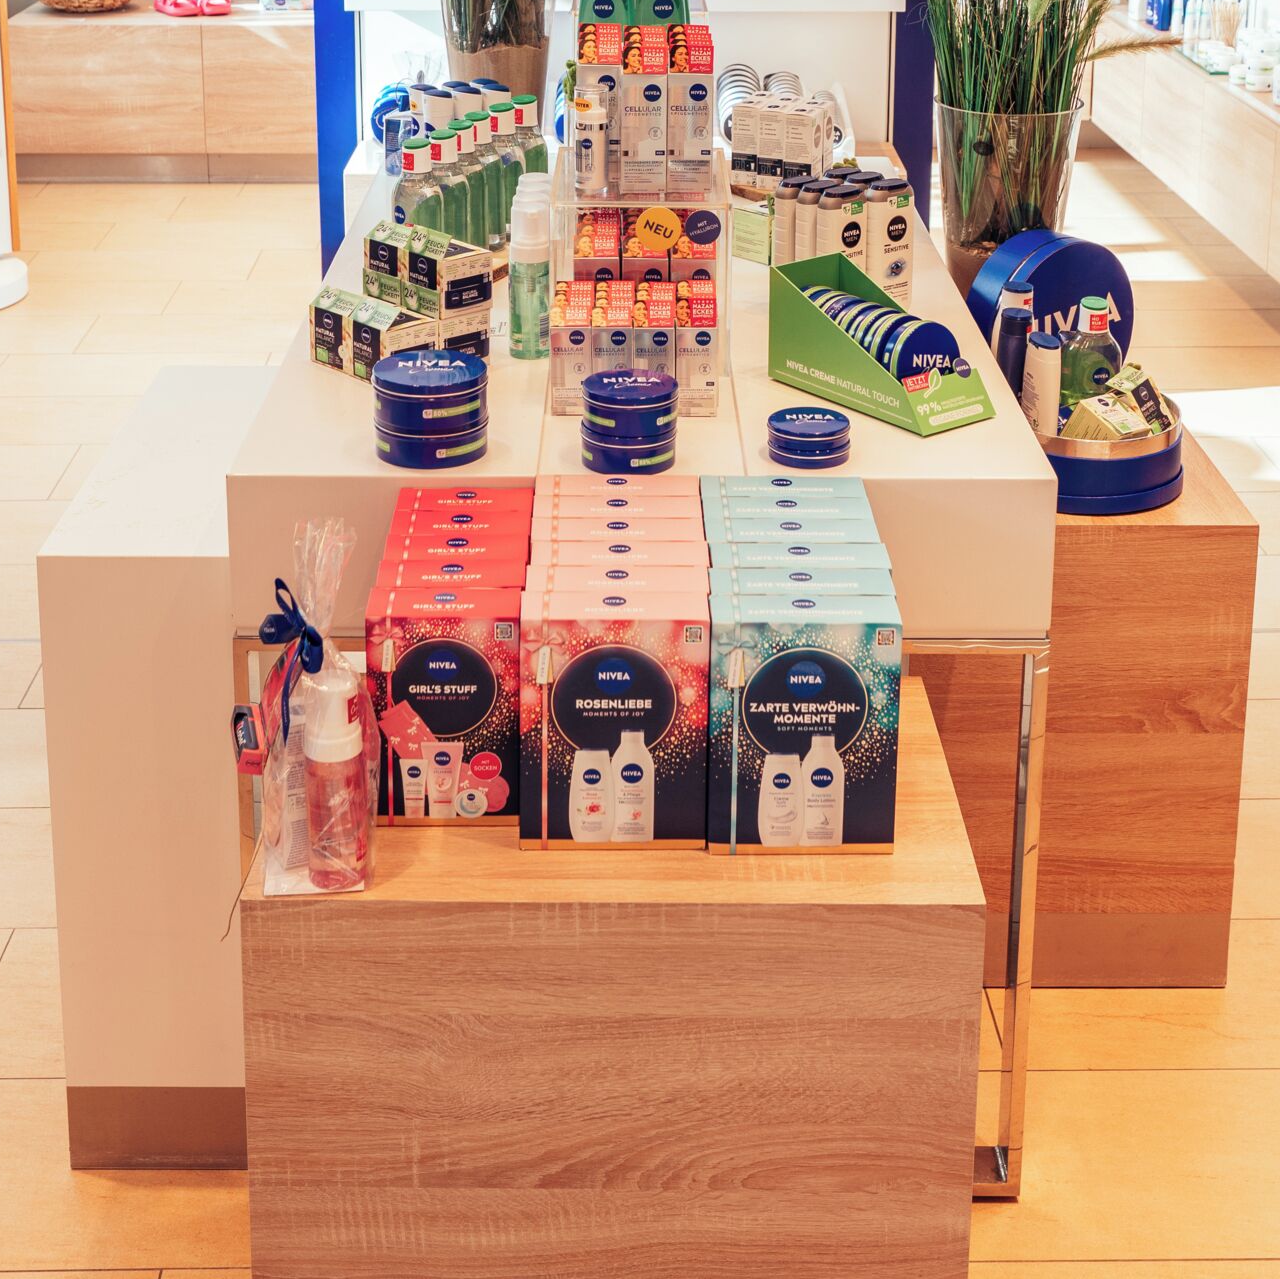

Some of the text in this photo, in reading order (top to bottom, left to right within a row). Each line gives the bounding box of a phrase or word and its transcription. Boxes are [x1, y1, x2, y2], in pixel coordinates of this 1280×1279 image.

[643, 219, 674, 239] NEU
[889, 223, 906, 232] NIVEA
[891, 228, 904, 236] MEN
[843, 229, 860, 238] NIVEA
[845, 234, 858, 243] MEN
[883, 244, 909, 254] SENSITIVE
[370, 260, 391, 270] NATURAL
[409, 273, 429, 283] NATURAL
[315, 327, 336, 338] NATURAL
[397, 359, 467, 368] NIVEA
[912, 354, 951, 369] NIVEA
[956, 364, 970, 372] NIVEA
[603, 376, 661, 384] NIVEA
[786, 359, 900, 408] NIVEA CREME NATURAL TOUCH
[905, 374, 926, 388] JETZT
[428, 661, 457, 670] NIVEA
[598, 672, 631, 681] NIVEA
[790, 675, 822, 684] NIVEA
[443, 685, 478, 694] STUFF
[575, 699, 653, 709] ROSENLIEBE
[750, 700, 861, 713] ZARTE VERWÖHN-
[774, 713, 836, 724] MOMENTE
